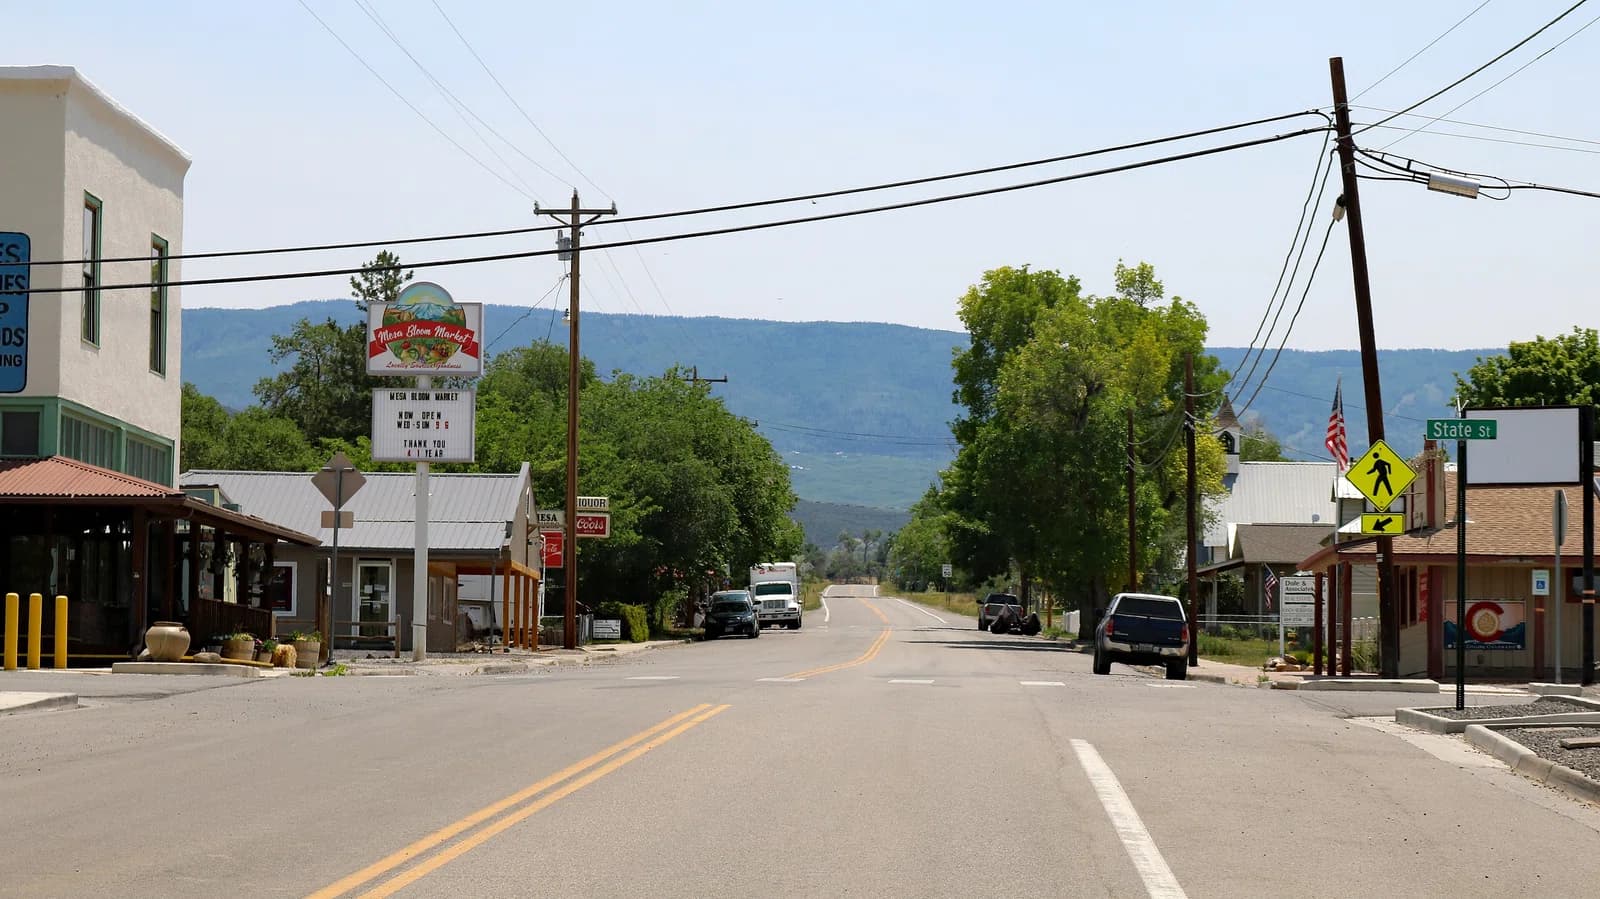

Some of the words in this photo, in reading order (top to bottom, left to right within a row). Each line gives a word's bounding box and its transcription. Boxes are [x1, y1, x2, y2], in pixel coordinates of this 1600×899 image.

[378, 329, 403, 343] Mesa
[406, 325, 431, 338] Bloom
[434, 325, 472, 343] Market
[389, 391, 406, 401] MESA
[411, 391, 430, 401] BLOOM
[435, 391, 458, 401] MARKET
[398, 411, 413, 420] NOW
[422, 411, 441, 420] OPEN
[1433, 422, 1472, 437] State
[1479, 425, 1491, 437] St
[404, 440, 427, 448] THANK
[433, 440, 446, 448] YOU
[425, 449, 443, 457] YEAR
[577, 498, 606, 508] IQUOR
[577, 518, 604, 530] Coors
